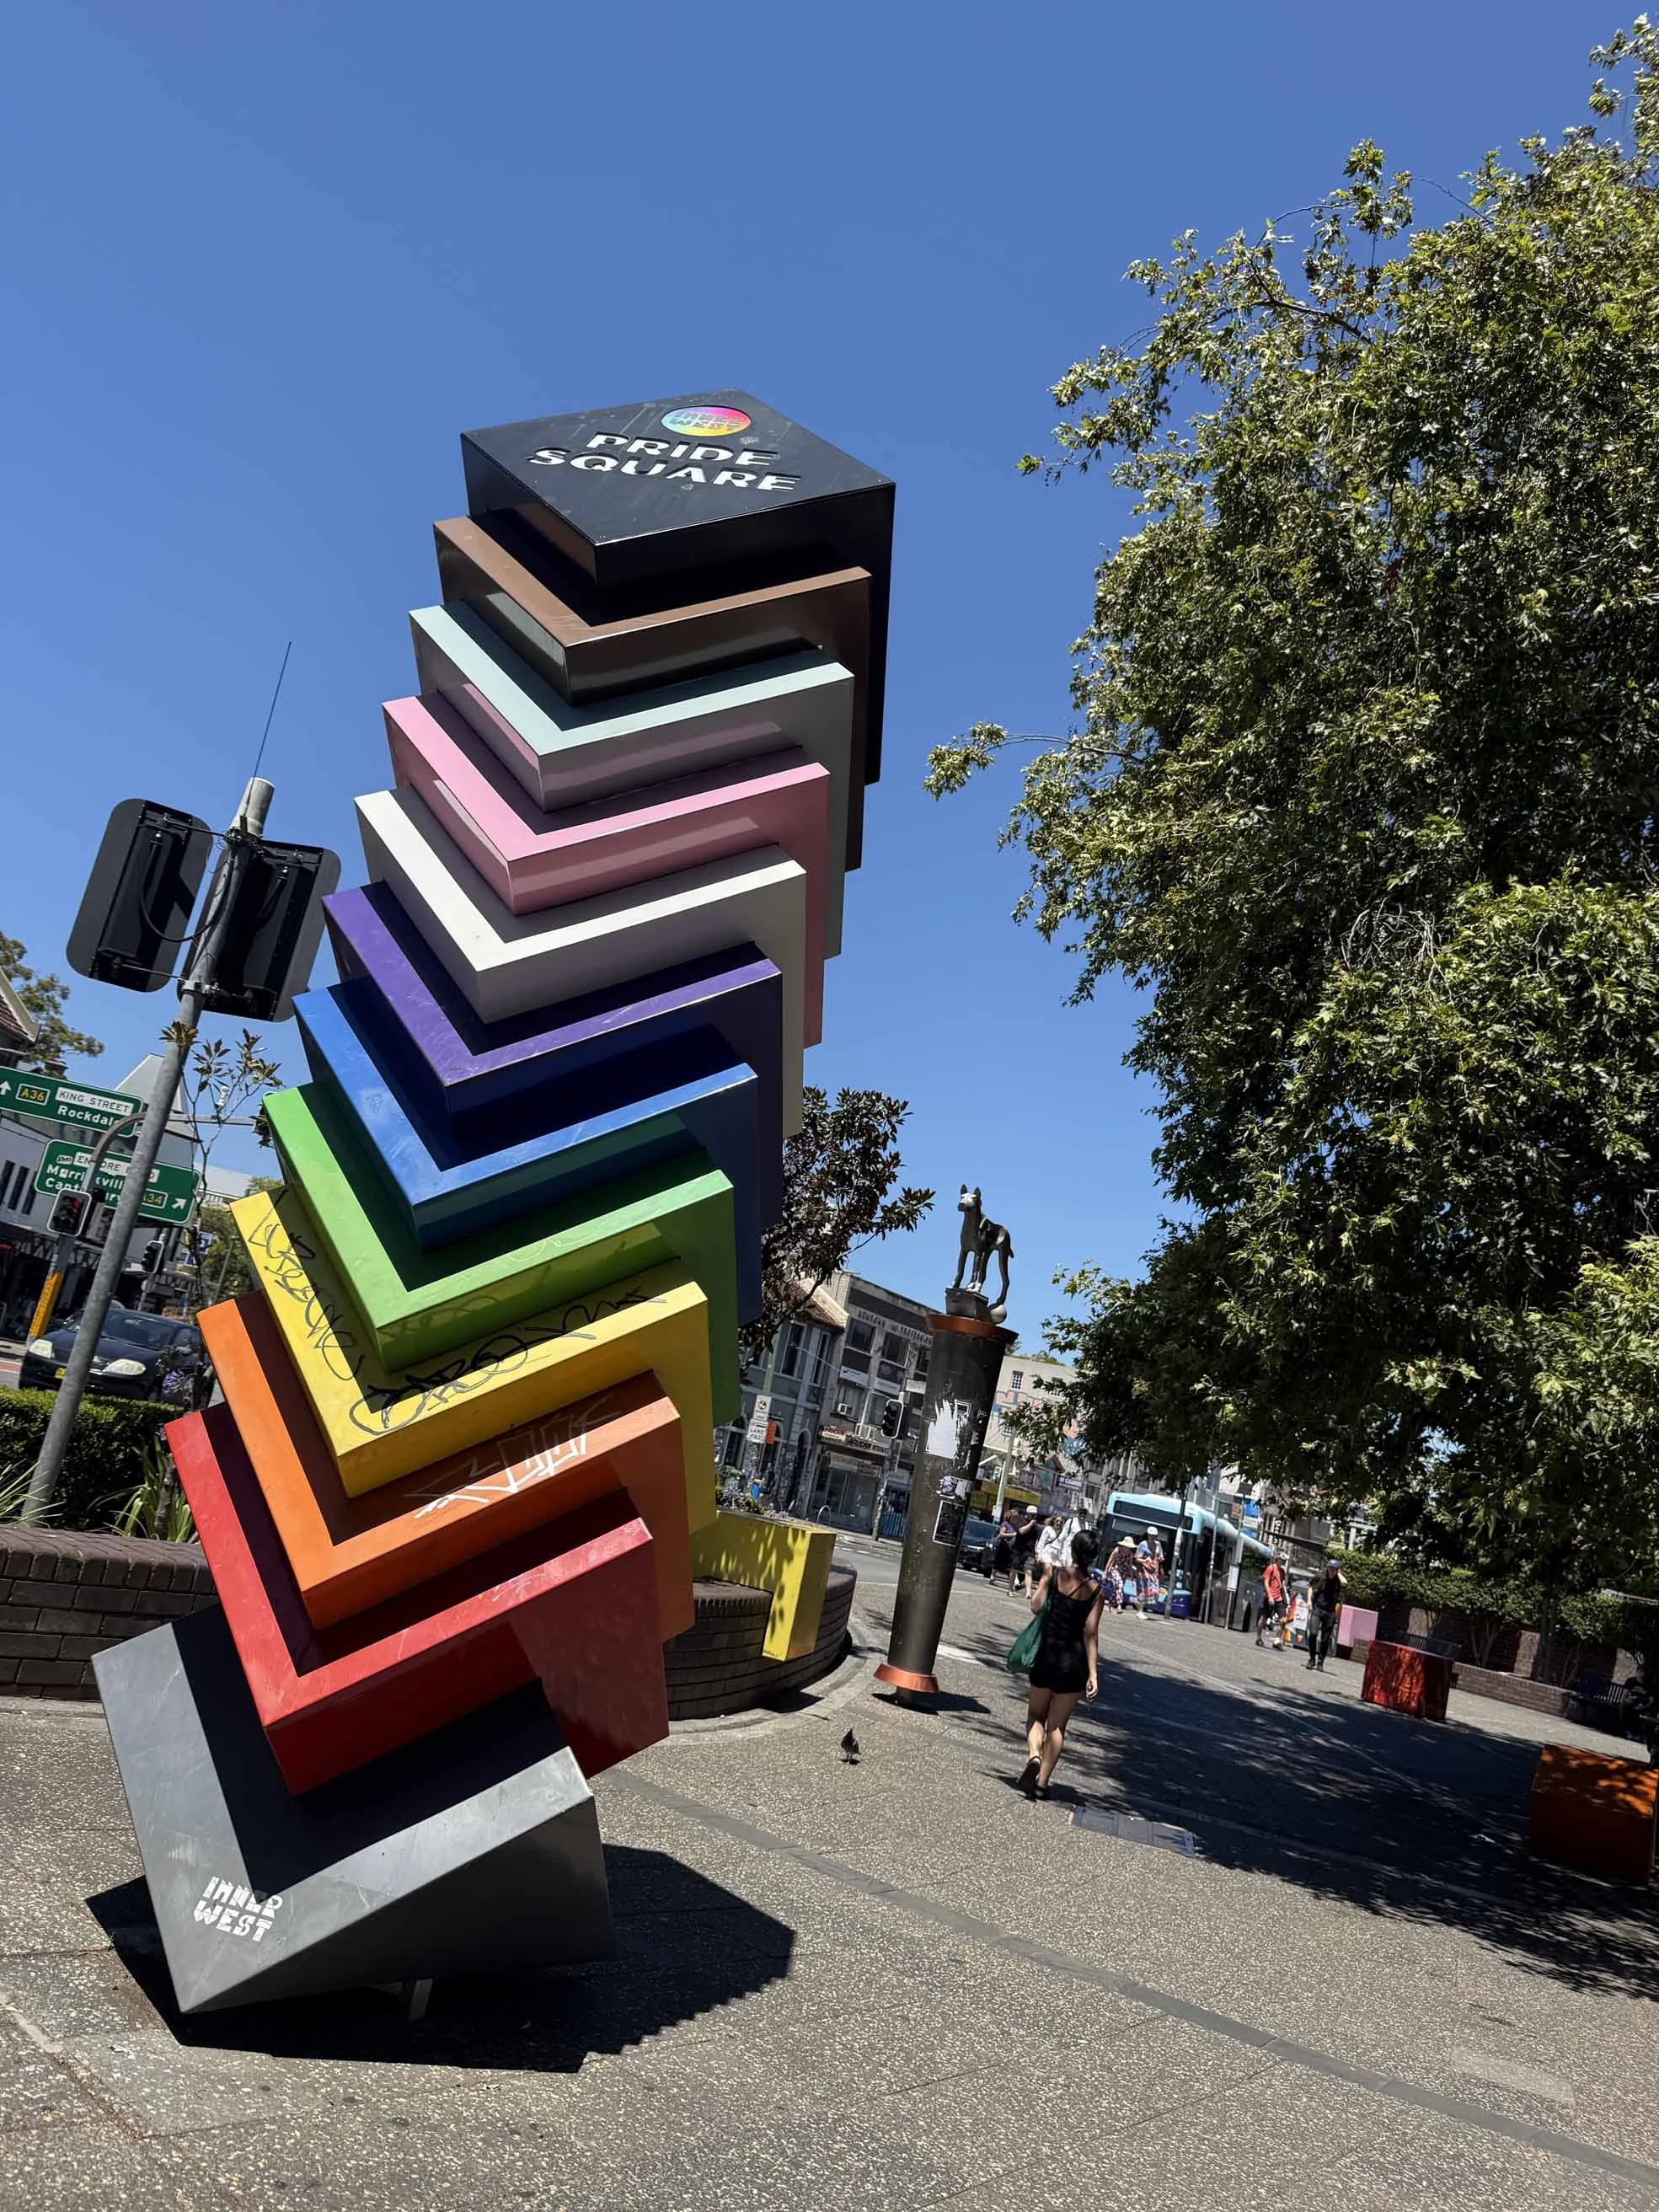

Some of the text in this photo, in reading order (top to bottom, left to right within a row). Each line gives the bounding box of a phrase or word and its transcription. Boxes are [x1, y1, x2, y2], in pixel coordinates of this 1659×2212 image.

[586, 431, 779, 466] PRIDE
[526, 447, 801, 493] SQUARE
[20, 1088, 45, 1101] A36
[59, 1090, 129, 1113] KING STREET
[78, 1155, 121, 1172] ENORE
[46, 1165, 126, 1190] Marrikvill
[144, 1192, 163, 1205] 34
[202, 1876, 283, 1920] INNER
[193, 1899, 273, 1942] WEST
